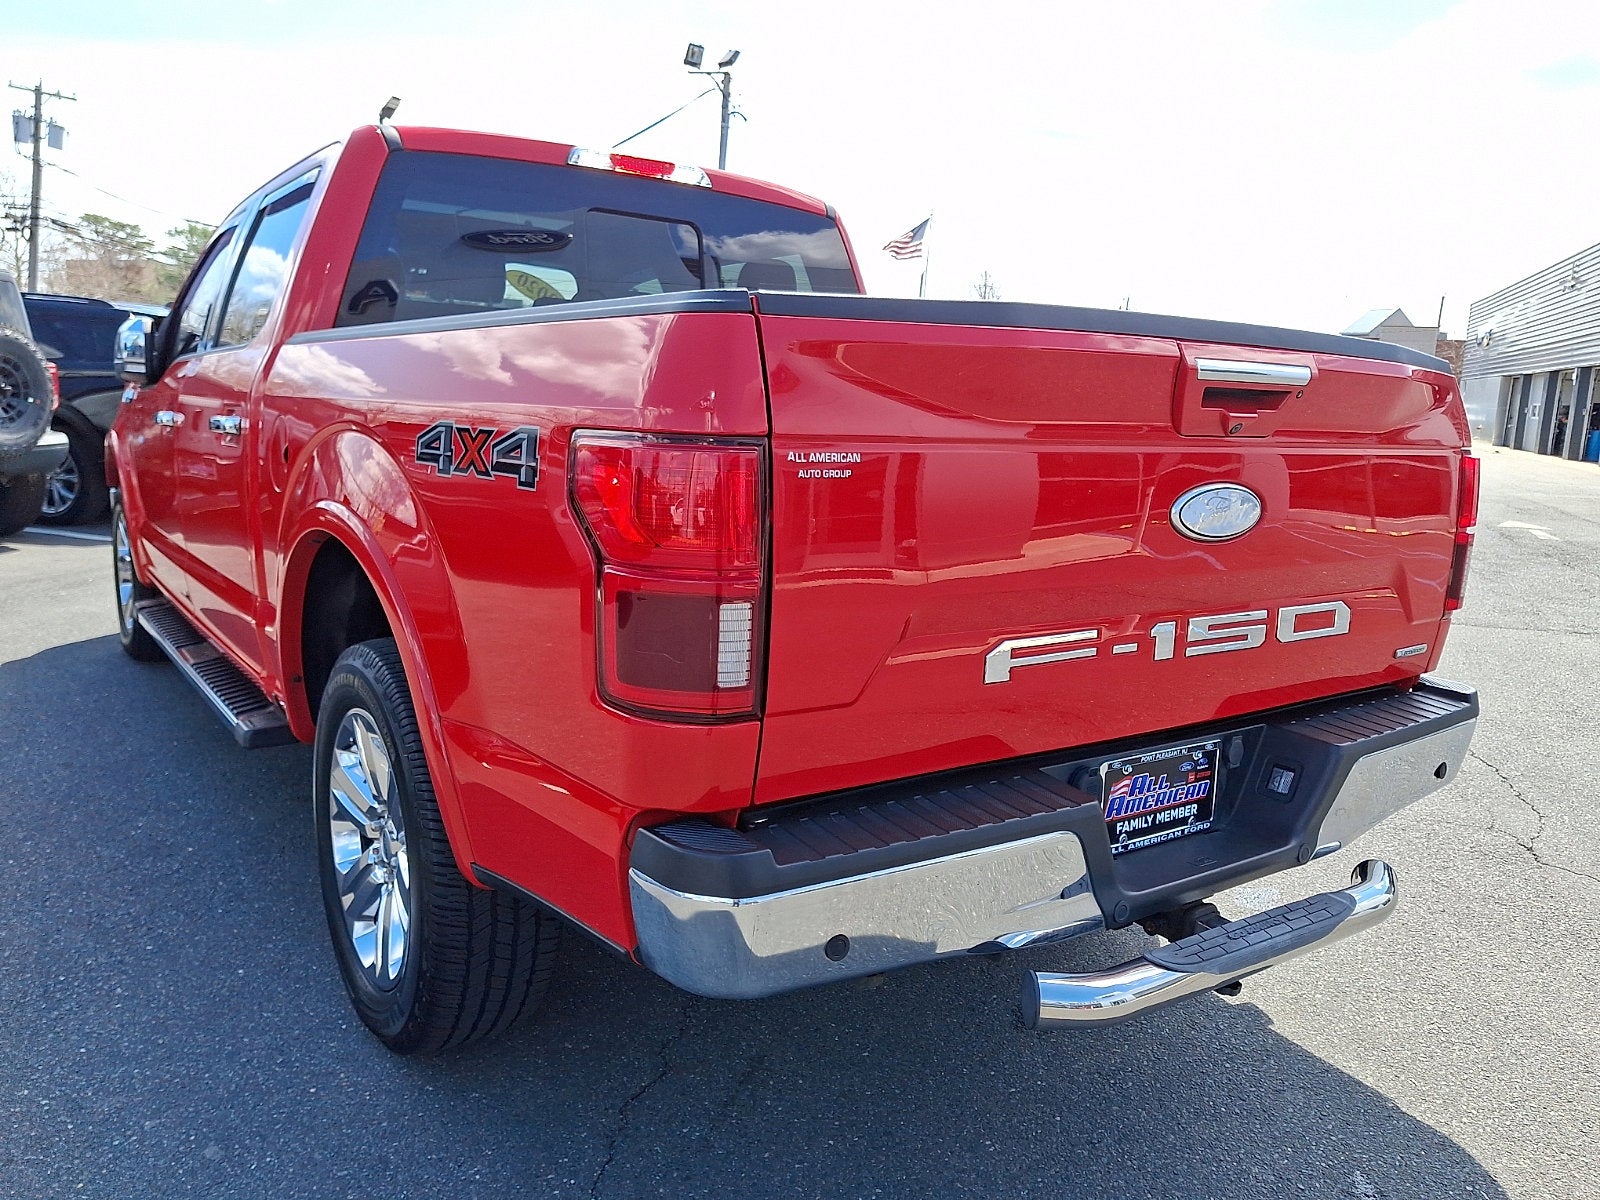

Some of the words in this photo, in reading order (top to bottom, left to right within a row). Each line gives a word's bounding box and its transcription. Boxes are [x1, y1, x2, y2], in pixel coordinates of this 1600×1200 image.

[787, 451, 807, 463] ALL
[808, 452, 861, 463] AMERICAN
[798, 469, 821, 478] AUTO
[822, 469, 852, 478] GROUP
[983, 600, 1351, 684] F-150
[1116, 814, 1154, 834] FAMILY
[1156, 804, 1198, 824] MEMBER
[1110, 845, 1125, 854] LL
[1127, 831, 1182, 850] AMERICAN
[1184, 822, 1211, 835] FORD
